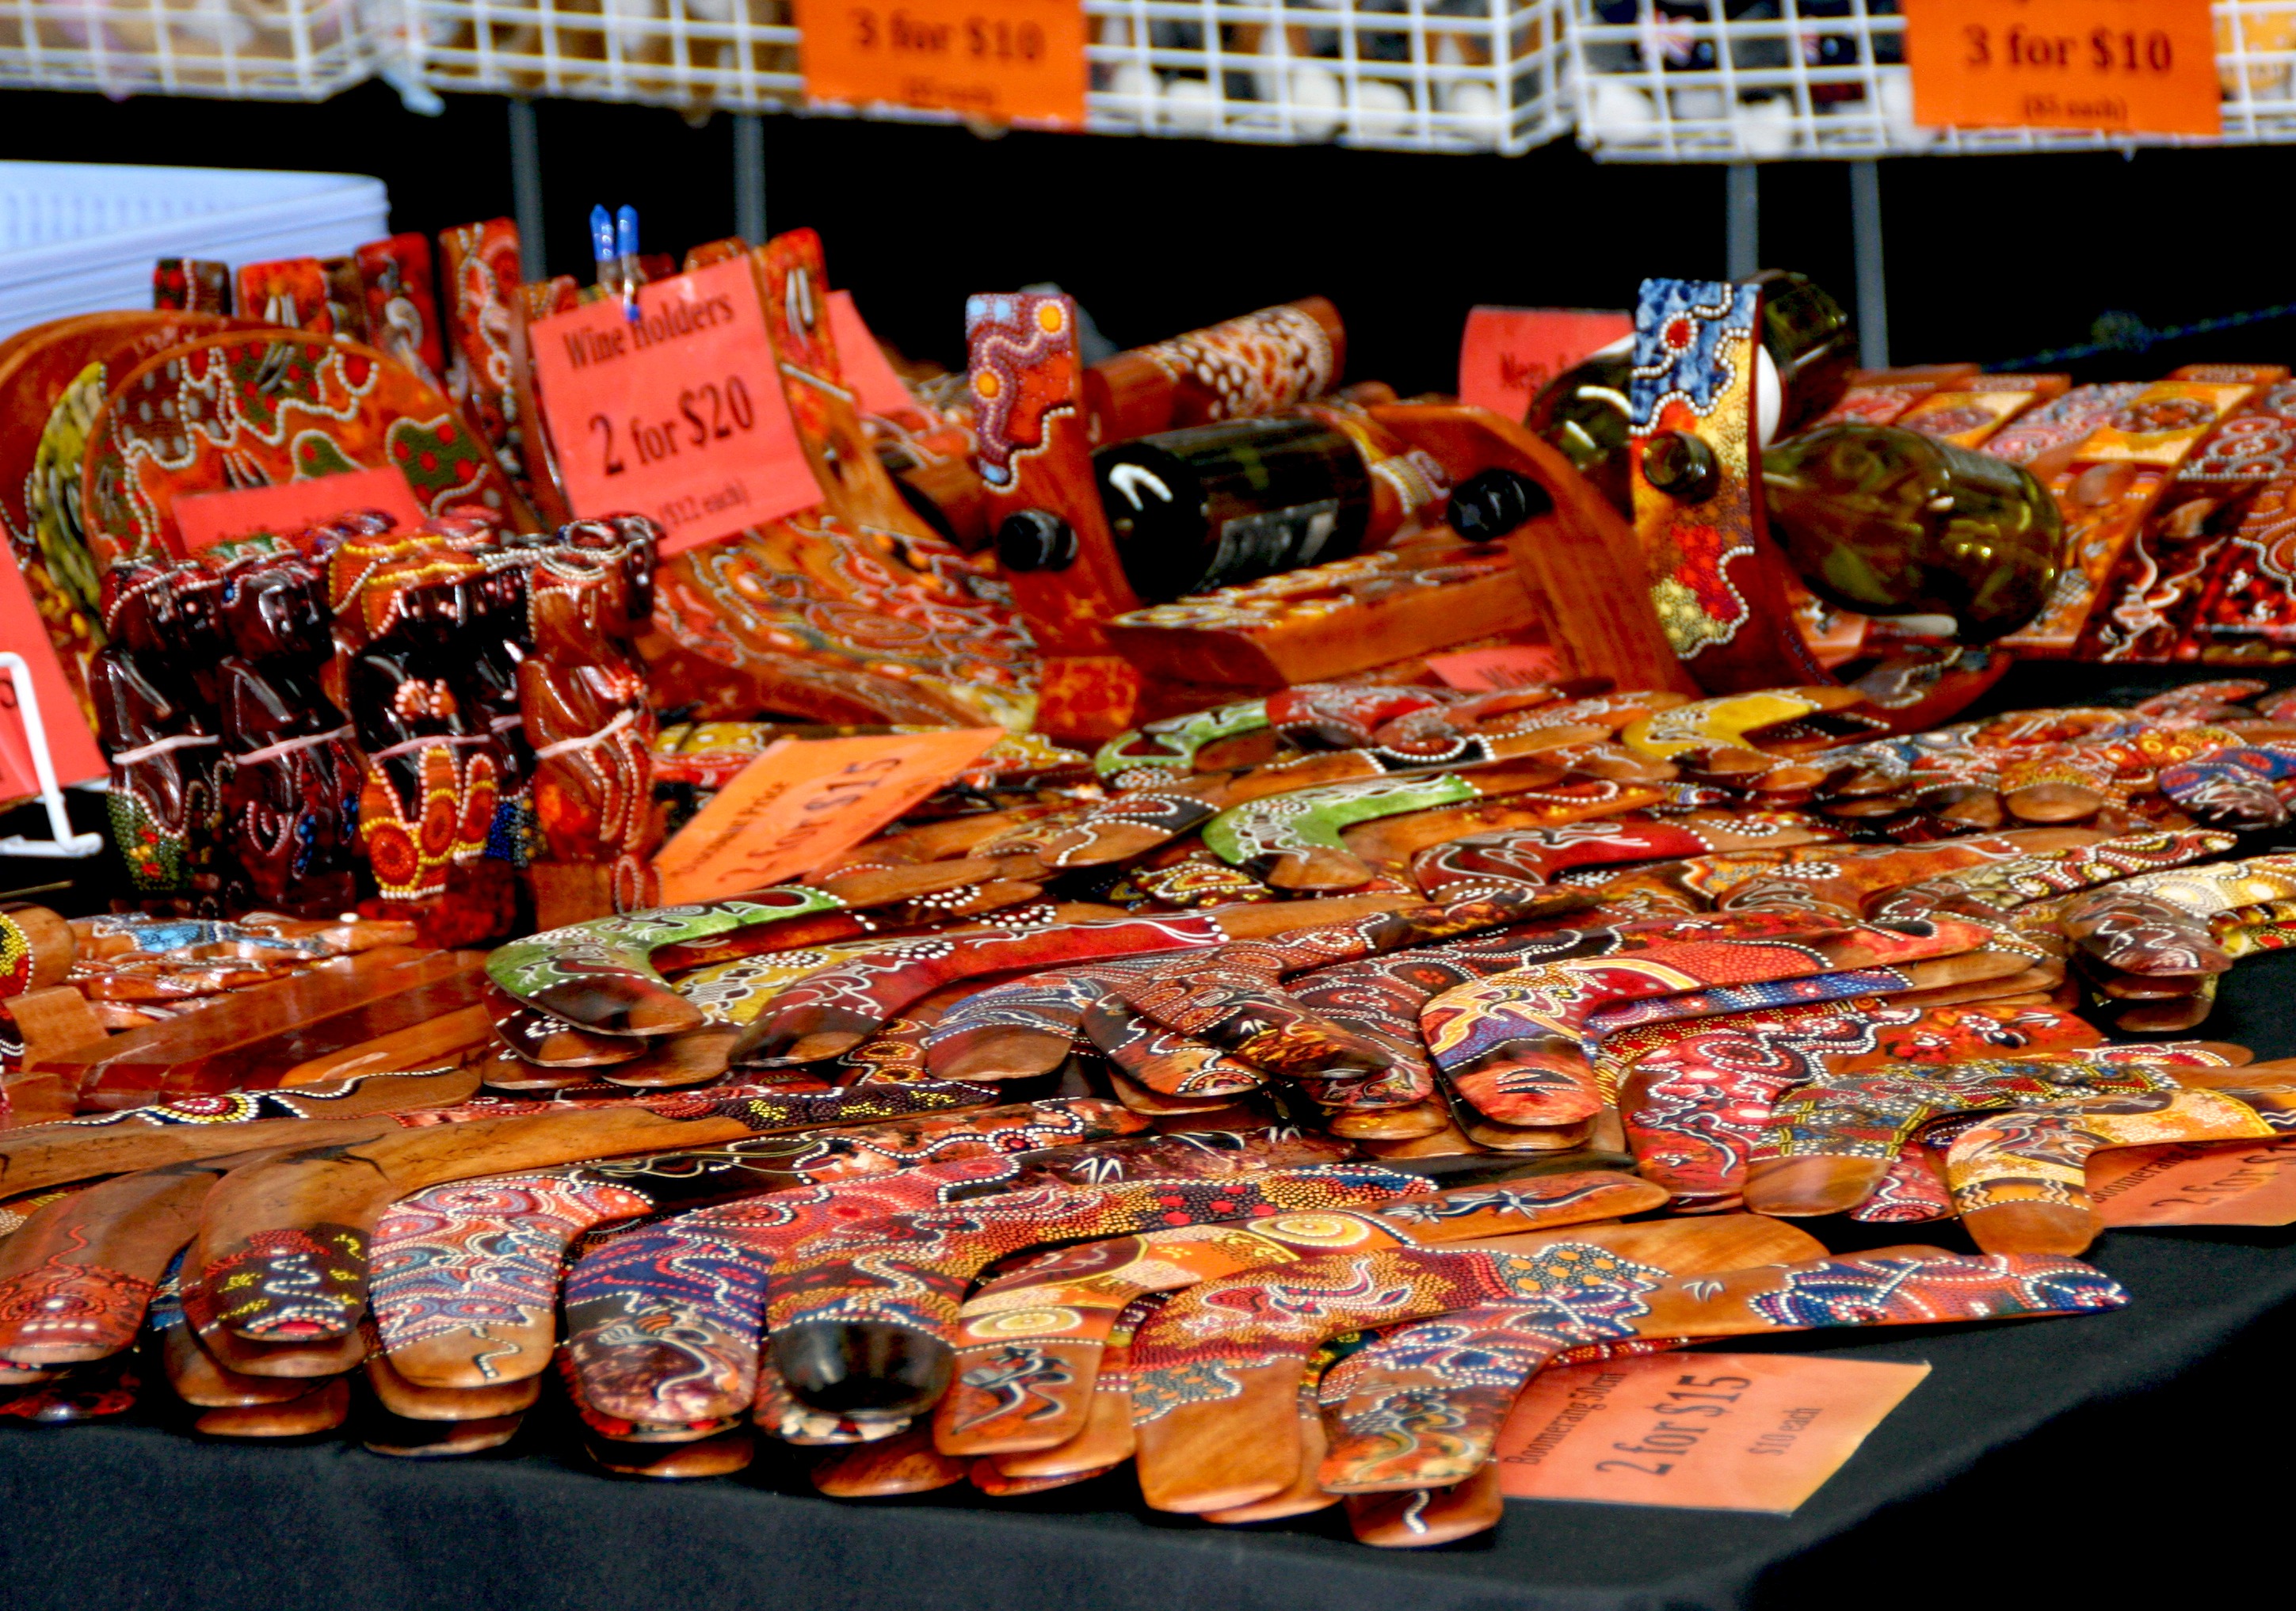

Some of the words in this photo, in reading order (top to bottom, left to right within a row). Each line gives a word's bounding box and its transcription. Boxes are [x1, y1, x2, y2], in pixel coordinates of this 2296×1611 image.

[850, 8, 878, 52] 3
[964, 16, 1046, 62] $10
[1964, 23, 1991, 67] 3
[2008, 23, 2075, 67] for
[2089, 25, 2172, 71] $10
[562, 326, 626, 369] Wine
[632, 293, 734, 351] Holders
[589, 413, 626, 477] 2
[630, 416, 681, 466] for
[678, 374, 754, 450] $20
[803, 758, 902, 811] $15
[2149, 1198, 2218, 1207] 2
[2180, 1168, 2281, 1193] for
[1504, 1402, 1608, 1464] Boomerang
[1568, 1373, 1627, 1400] 50cm
[1646, 1375, 1752, 1417] $15
[1612, 1421, 1709, 1455] for
[1748, 1434, 1797, 1456] $10
[1778, 1407, 1825, 1432] each
[1595, 1460, 1673, 1476] 2
